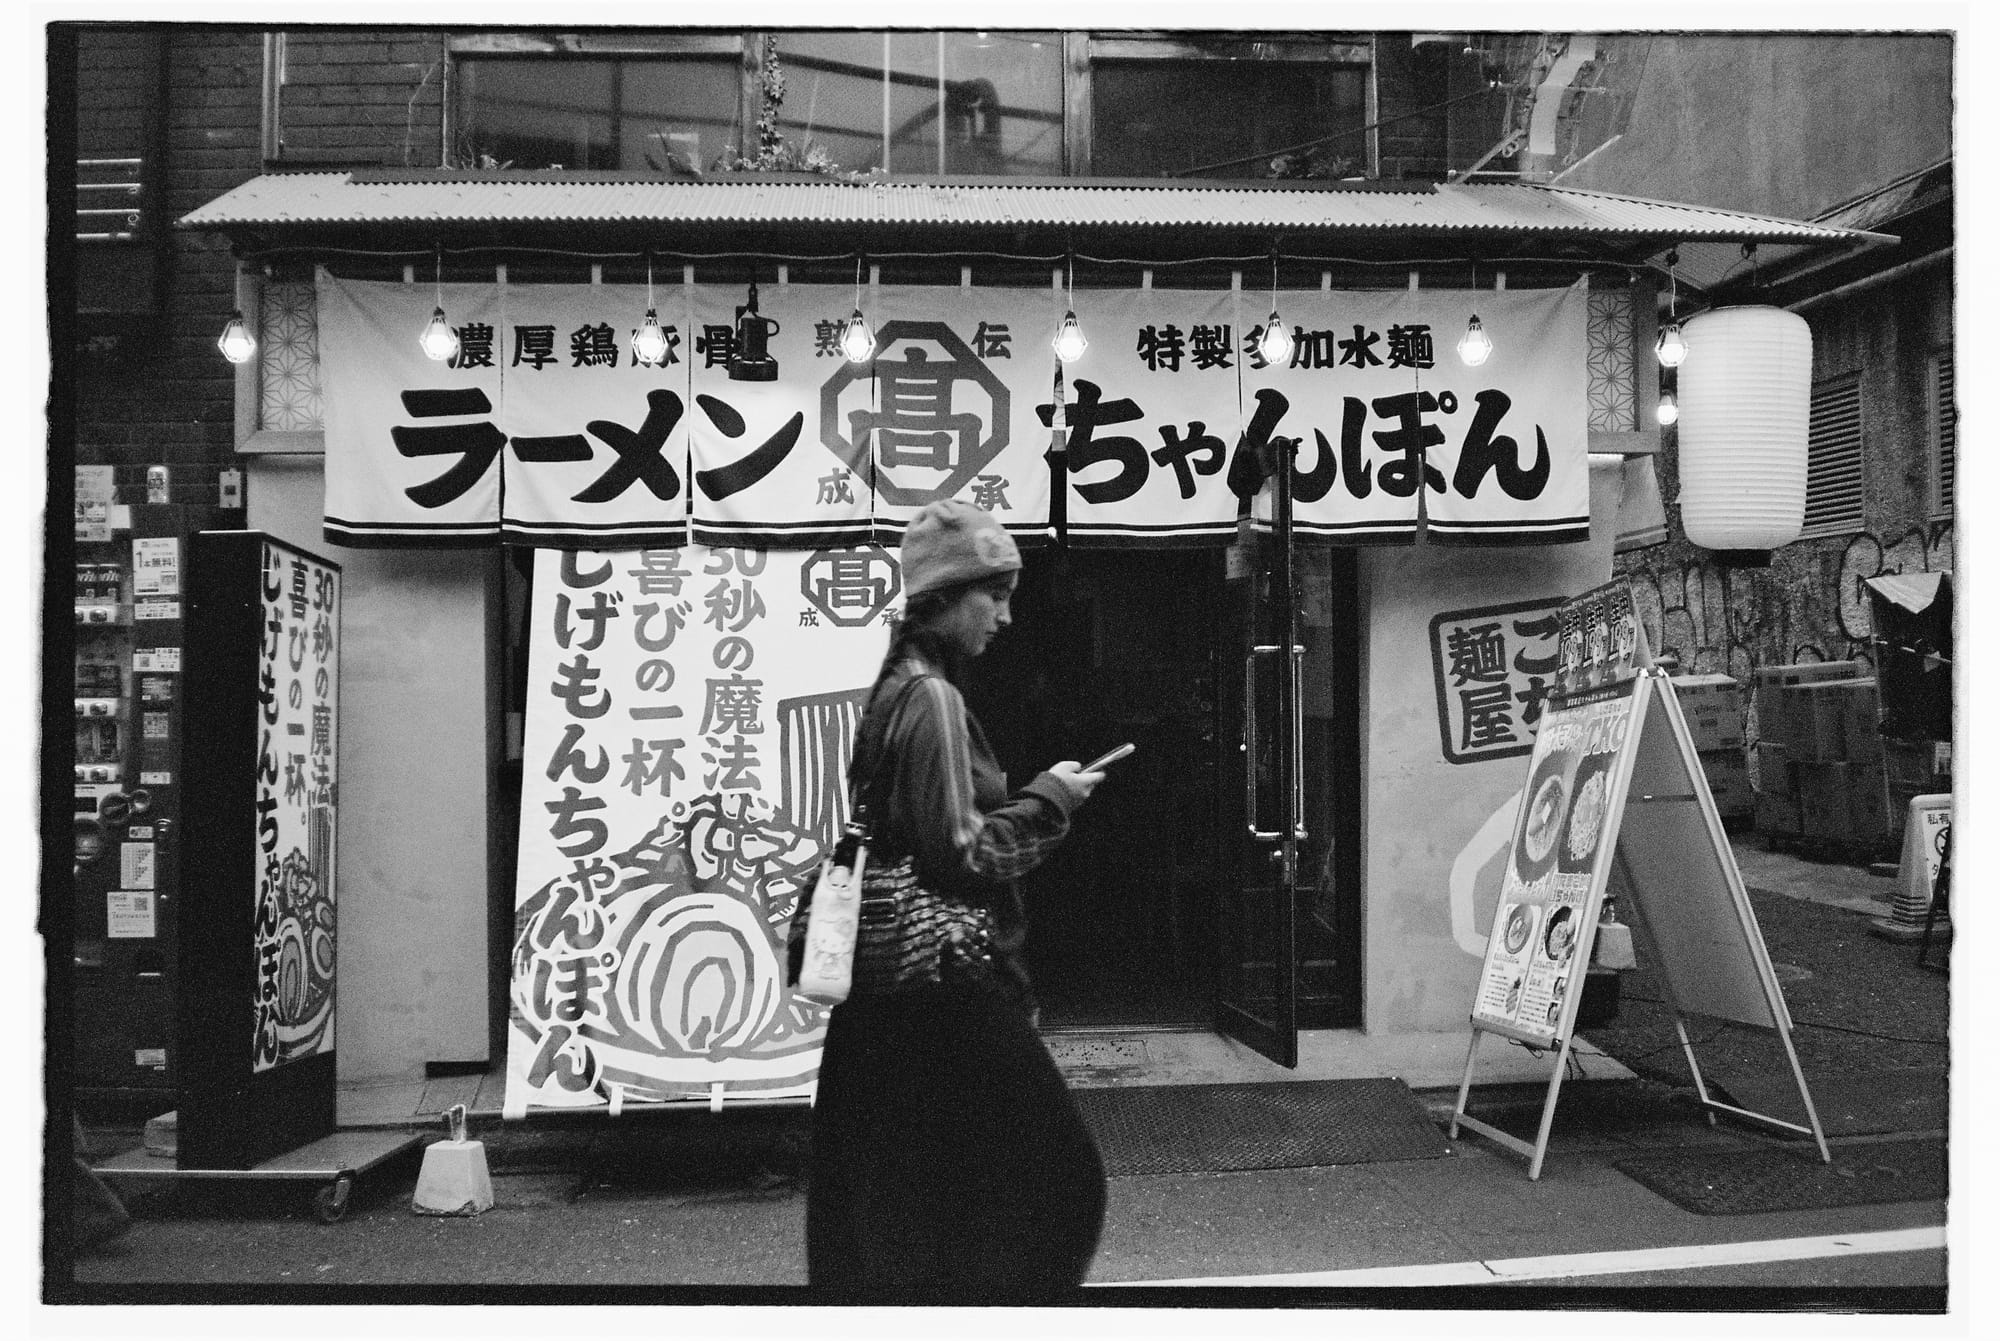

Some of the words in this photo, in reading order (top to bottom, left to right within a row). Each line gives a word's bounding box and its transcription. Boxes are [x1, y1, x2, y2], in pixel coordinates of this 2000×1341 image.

[390, 387, 804, 509] ラーメン
[1035, 378, 1551, 504] ちゃんぽん
[1446, 622, 1518, 750] 麺屋
